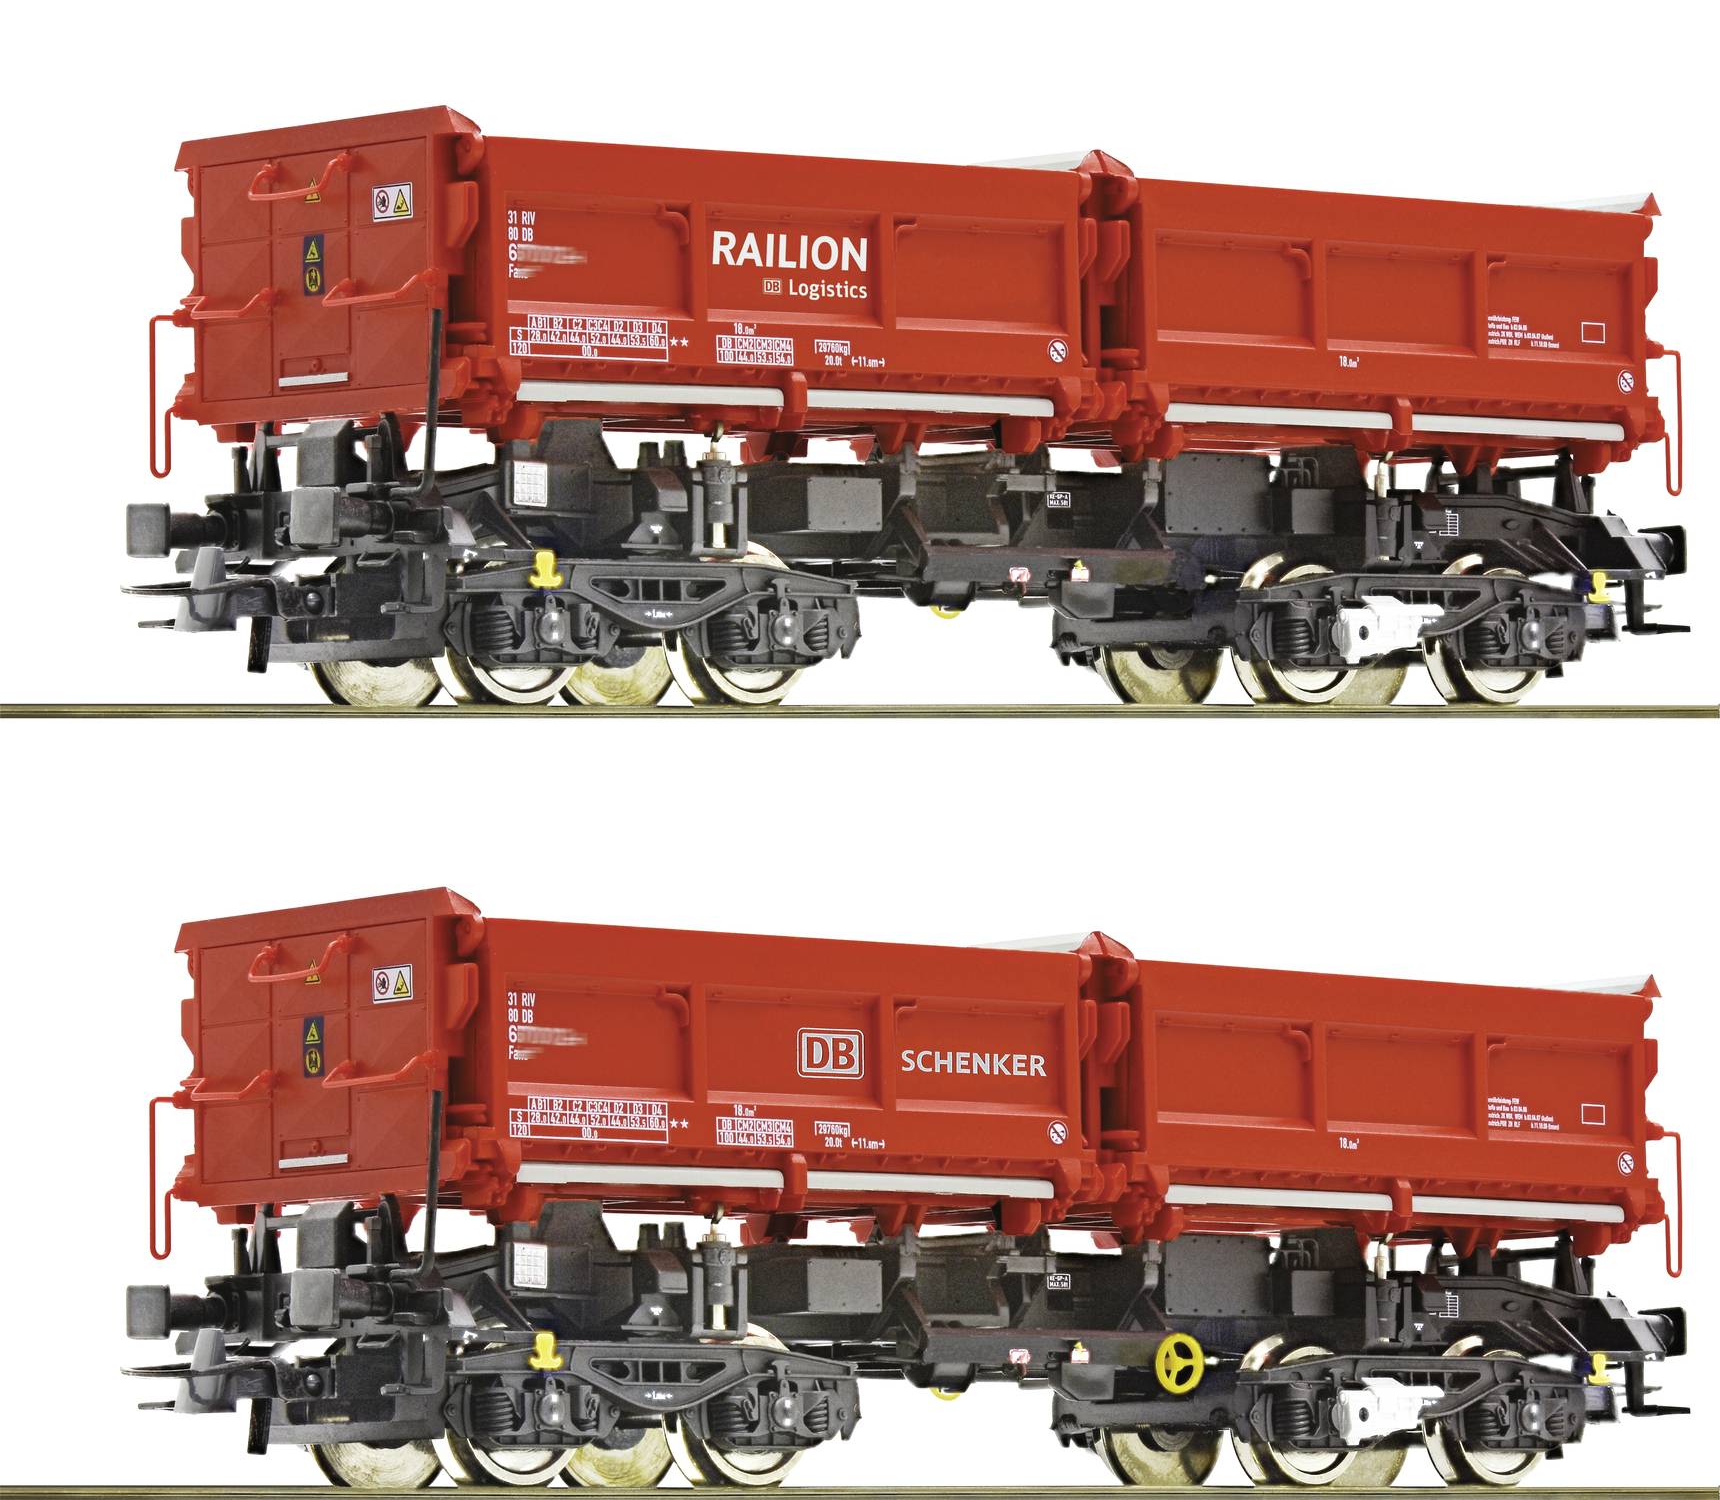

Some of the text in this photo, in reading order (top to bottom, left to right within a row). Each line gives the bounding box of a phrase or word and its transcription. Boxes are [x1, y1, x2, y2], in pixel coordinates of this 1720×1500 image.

[521, 211, 536, 225] RIV
[508, 226, 533, 242] 80 DB
[712, 230, 868, 272] RAILION
[763, 278, 868, 300] DB Logistics
[553, 318, 563, 330] B2
[572, 319, 583, 331] C2
[569, 331, 586, 344] 44.0
[590, 333, 607, 345] 52.0
[611, 333, 627, 346] 44.0
[630, 334, 646, 346] 53.5
[738, 337, 754, 350] CM2
[756, 338, 772, 351] CM3
[775, 339, 791, 351] CM4
[512, 342, 528, 354] 120
[720, 350, 734, 361] 100
[757, 351, 773, 363] 53.5
[521, 993, 536, 1007] RIV
[508, 1008, 533, 1024] 80 DB
[802, 1032, 1047, 1077] DB SCHENKER
[553, 1100, 563, 1112] B2
[572, 1101, 583, 1113] C2
[569, 1113, 586, 1126] 44.0
[590, 1115, 607, 1127] 52.0
[611, 1115, 627, 1128] 44.0
[630, 1116, 646, 1128] 53.5
[738, 1119, 754, 1132] CM2
[756, 1120, 772, 1133] CM3
[775, 1121, 791, 1133] CM4
[512, 1124, 528, 1136] 120
[720, 1132, 734, 1143] 100
[757, 1133, 773, 1145] 53.5
